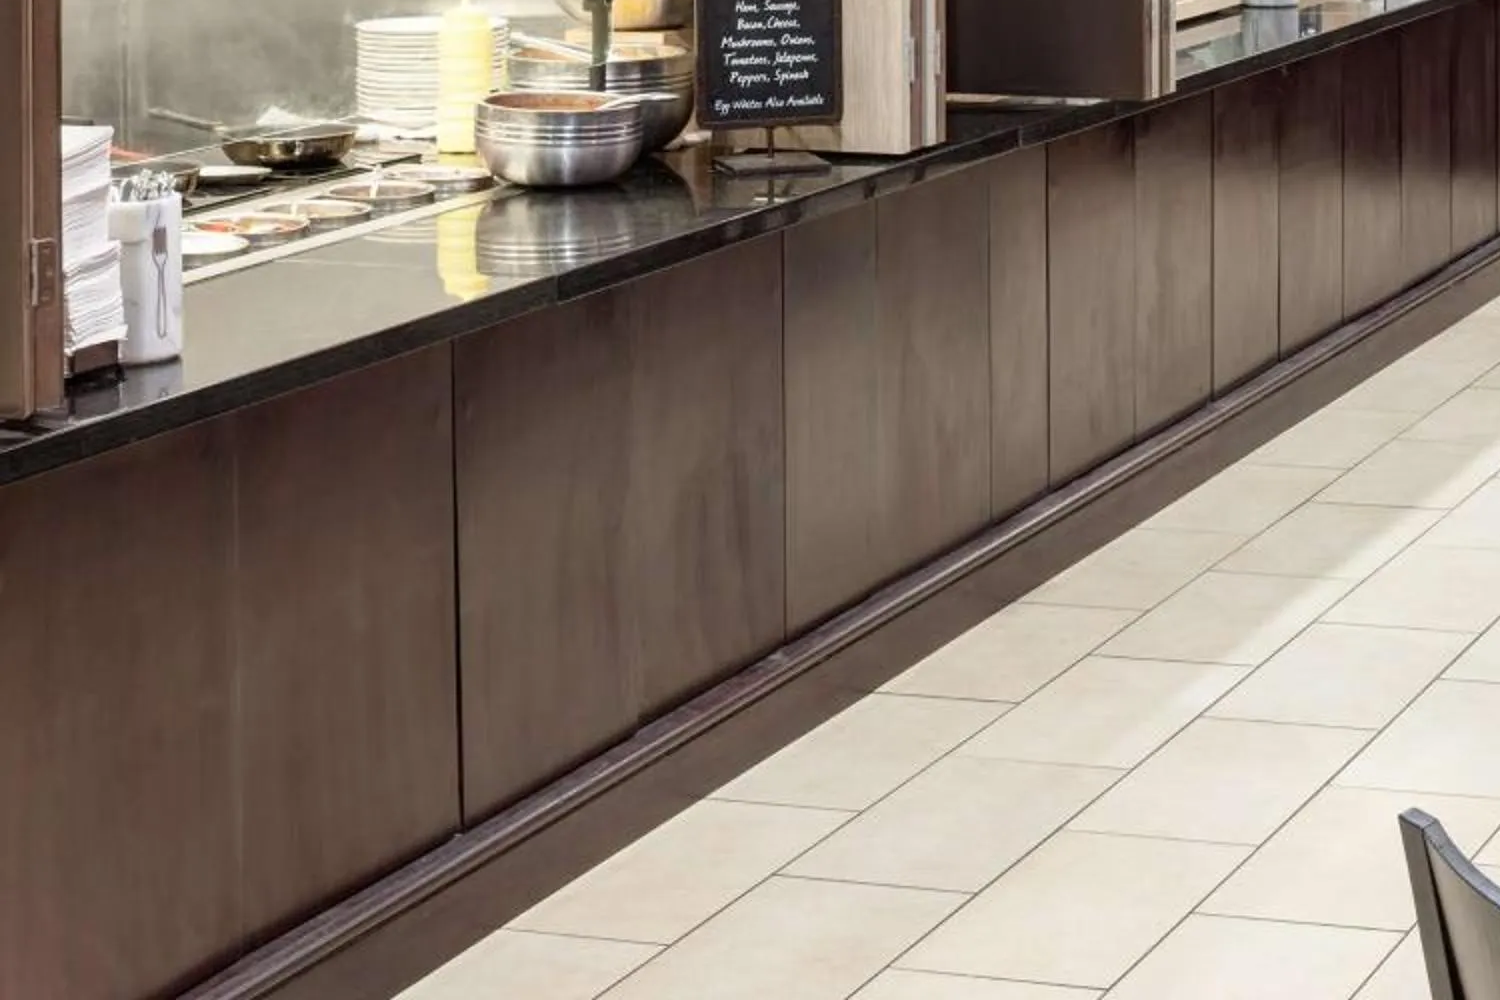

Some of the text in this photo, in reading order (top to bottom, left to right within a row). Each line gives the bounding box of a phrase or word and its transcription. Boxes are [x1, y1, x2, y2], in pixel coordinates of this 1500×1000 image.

[773, 68, 809, 86] Spinach
[714, 99, 731, 116] Egg
[764, 96, 785, 108] Also
[786, 93, 824, 107] Available
